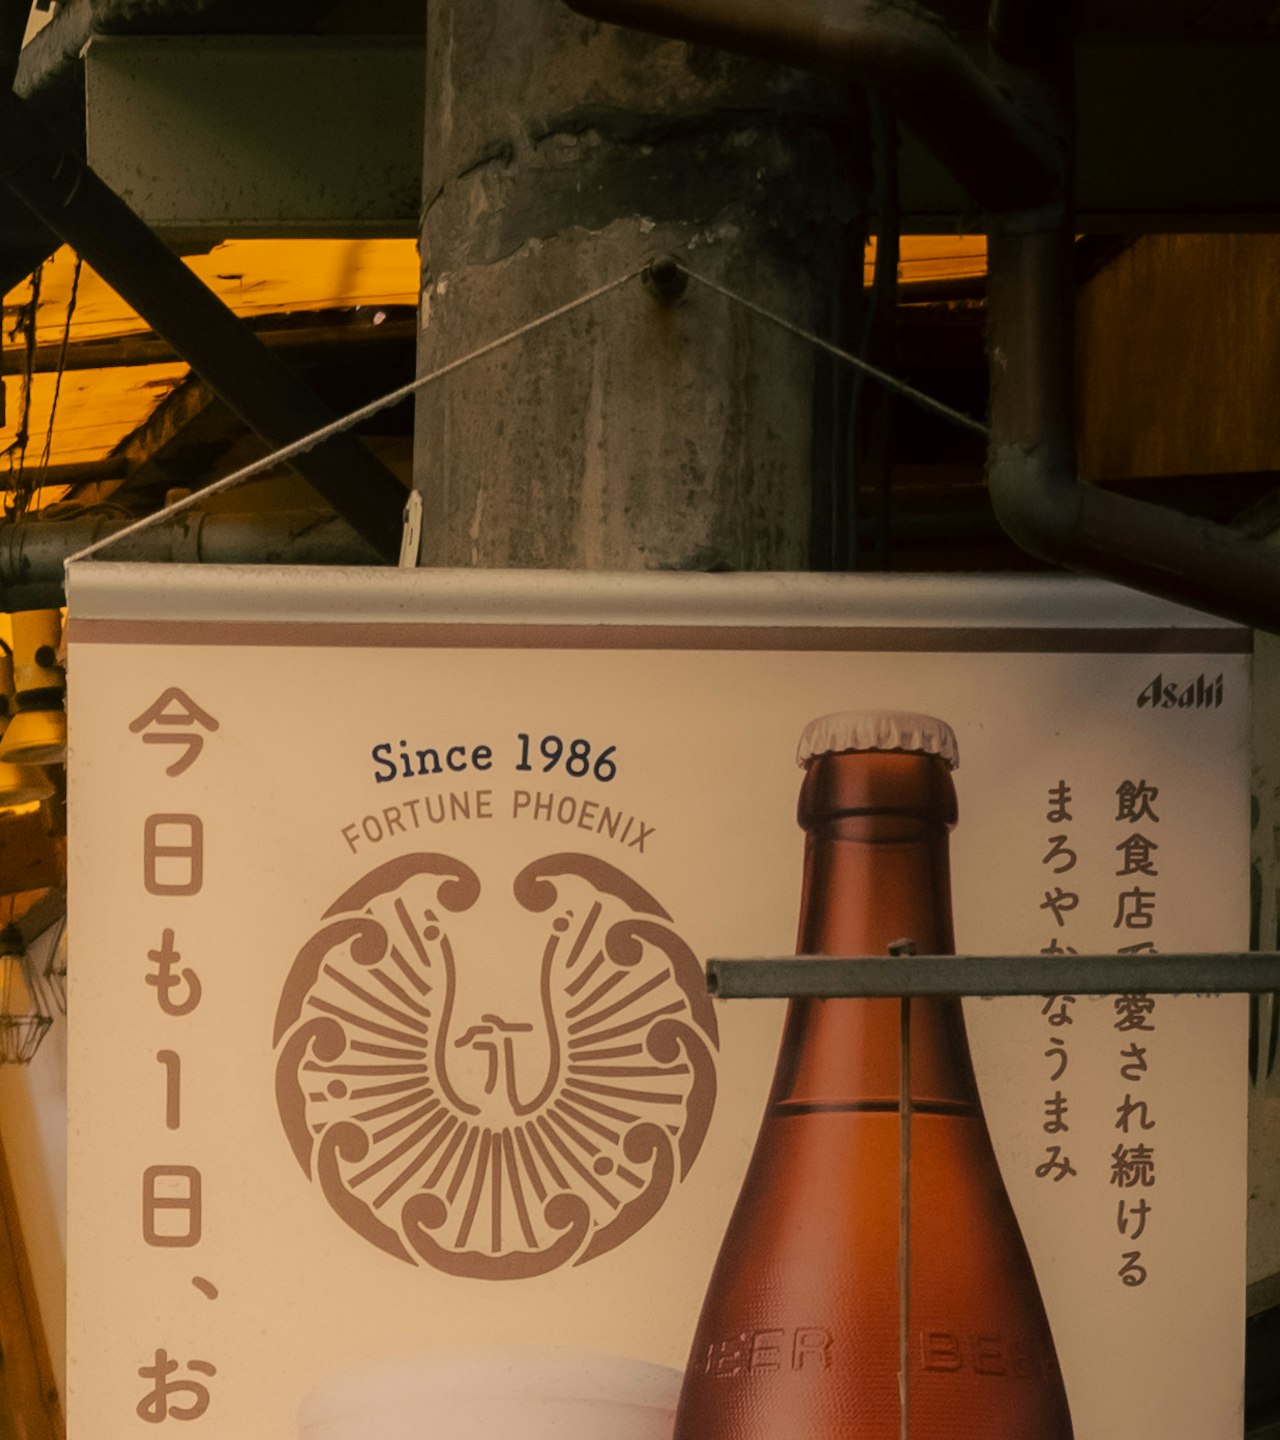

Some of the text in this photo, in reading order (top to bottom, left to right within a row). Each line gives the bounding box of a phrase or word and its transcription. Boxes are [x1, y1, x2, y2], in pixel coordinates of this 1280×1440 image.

[1137, 673, 1226, 714] Asahi
[371, 731, 620, 786] Since 1986
[340, 789, 658, 858] FORTUNE PHOENIX
[1110, 779, 1162, 1291] 飲食店愛され続ける
